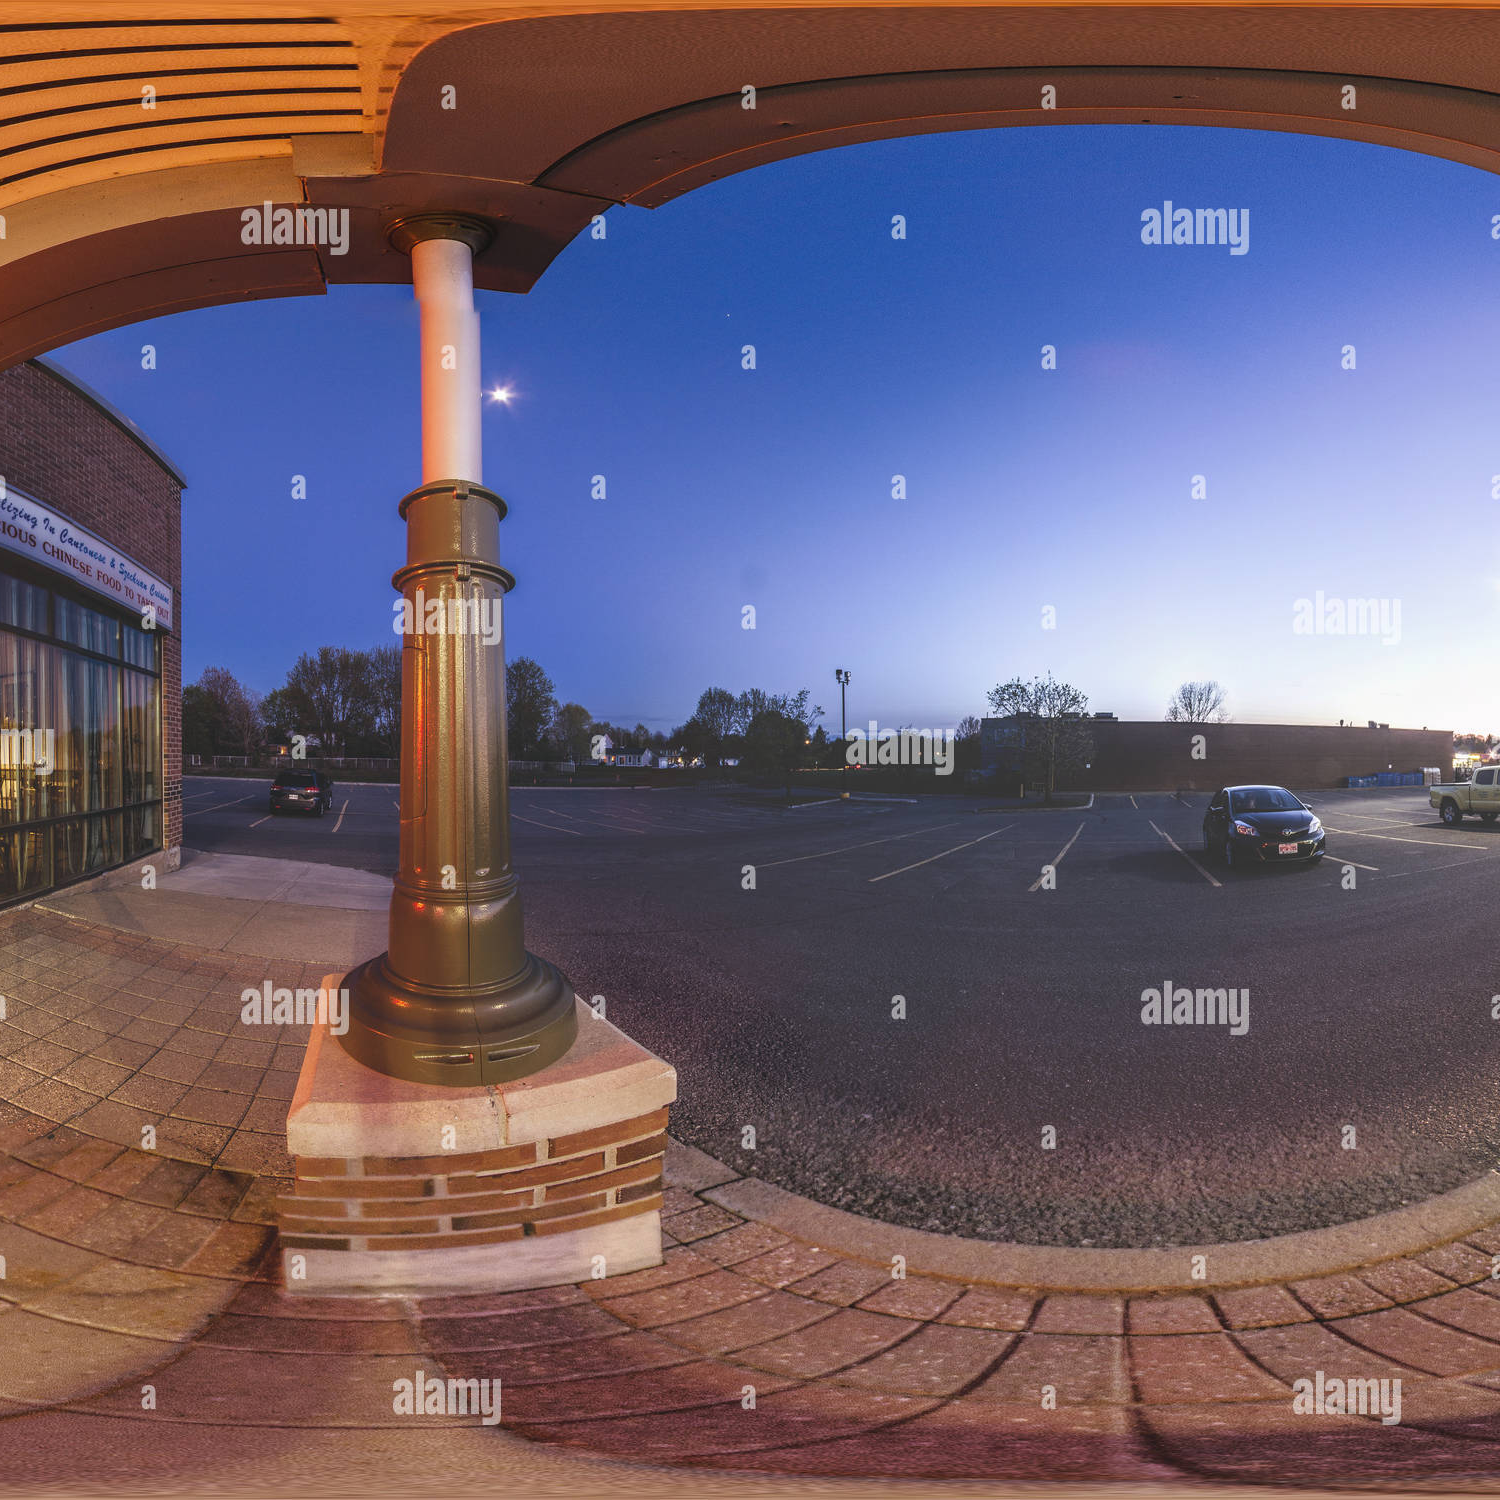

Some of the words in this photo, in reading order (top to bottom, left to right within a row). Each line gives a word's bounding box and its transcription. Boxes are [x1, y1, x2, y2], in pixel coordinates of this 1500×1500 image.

[42, 541, 93, 578] CHINESE
[96, 569, 122, 593] FOOD
[124, 585, 135, 601] TO
[157, 605, 169, 620] OUT
[43, 517, 56, 535] In
[59, 528, 107, 565] Cantonese
[110, 558, 116, 569] &
[119, 562, 148, 591] Szechuan
[149, 583, 170, 605] Cuisine
